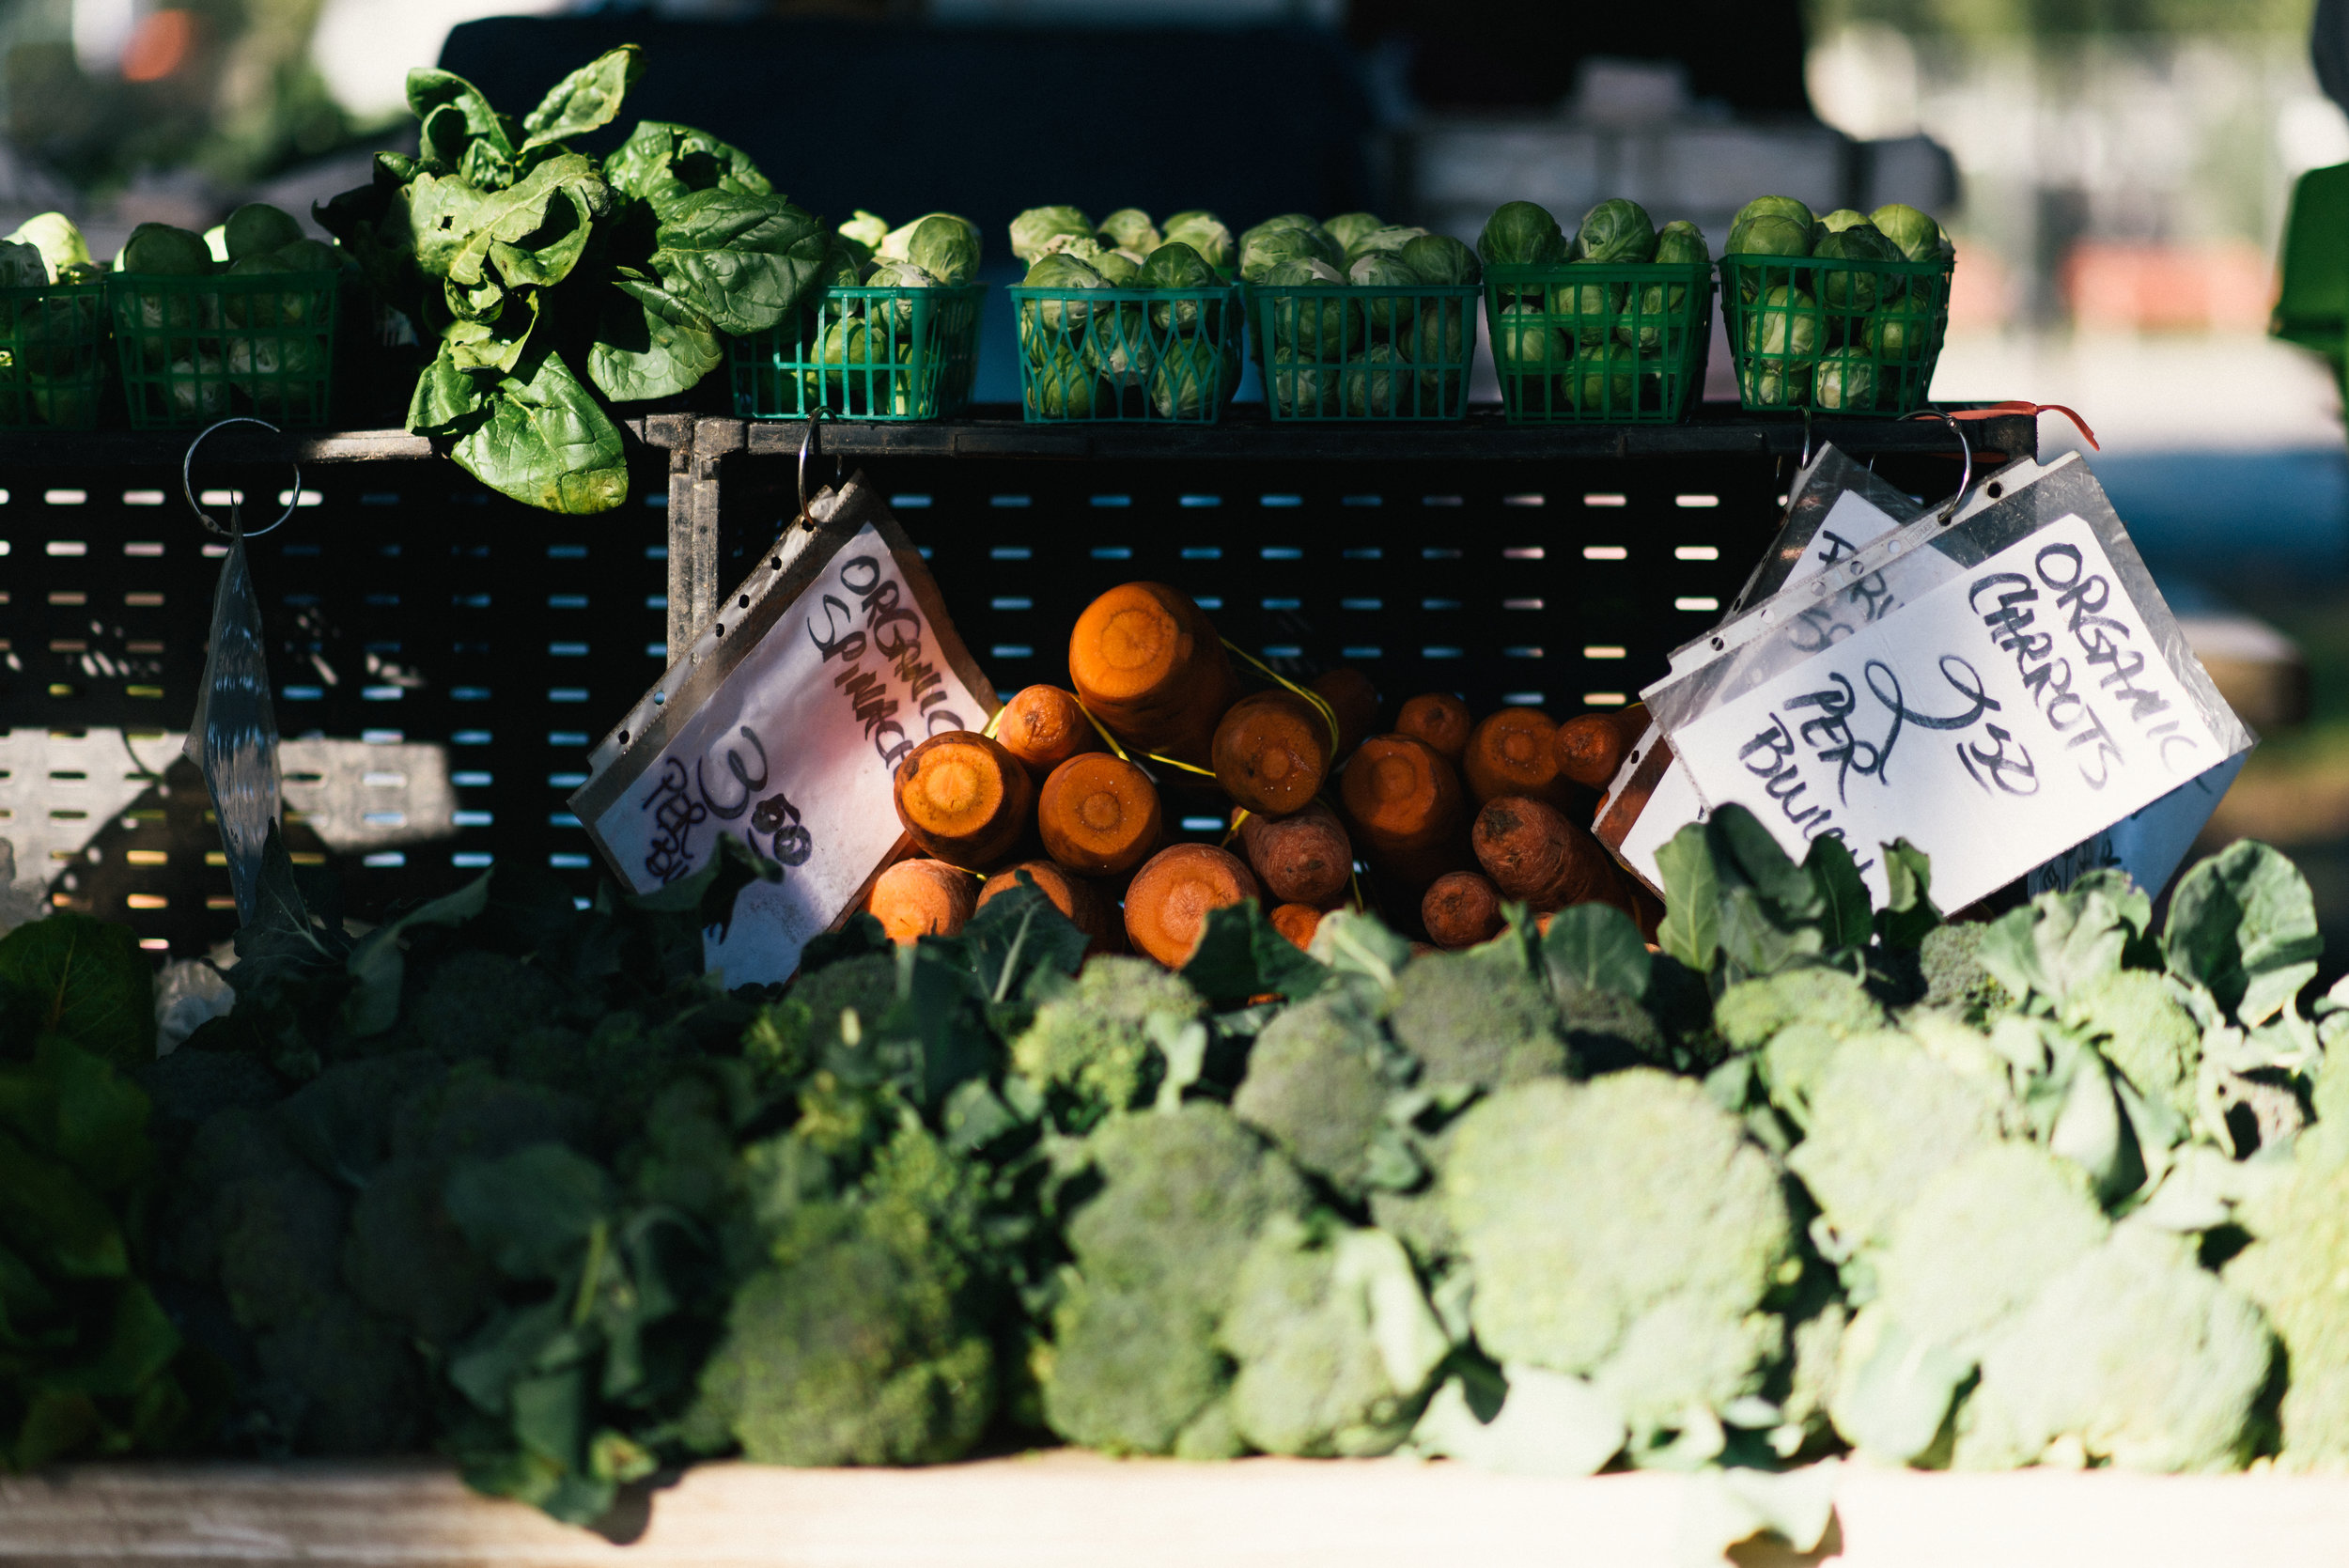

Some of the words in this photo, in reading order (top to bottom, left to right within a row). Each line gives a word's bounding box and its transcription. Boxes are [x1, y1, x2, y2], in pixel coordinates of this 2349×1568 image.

[841, 555, 964, 736] ORGANIC
[1968, 572, 2123, 790] CARROTS
[2035, 542, 2198, 774] ORGANIC
[643, 756, 707, 860] PER
[1782, 671, 1879, 808] PER
